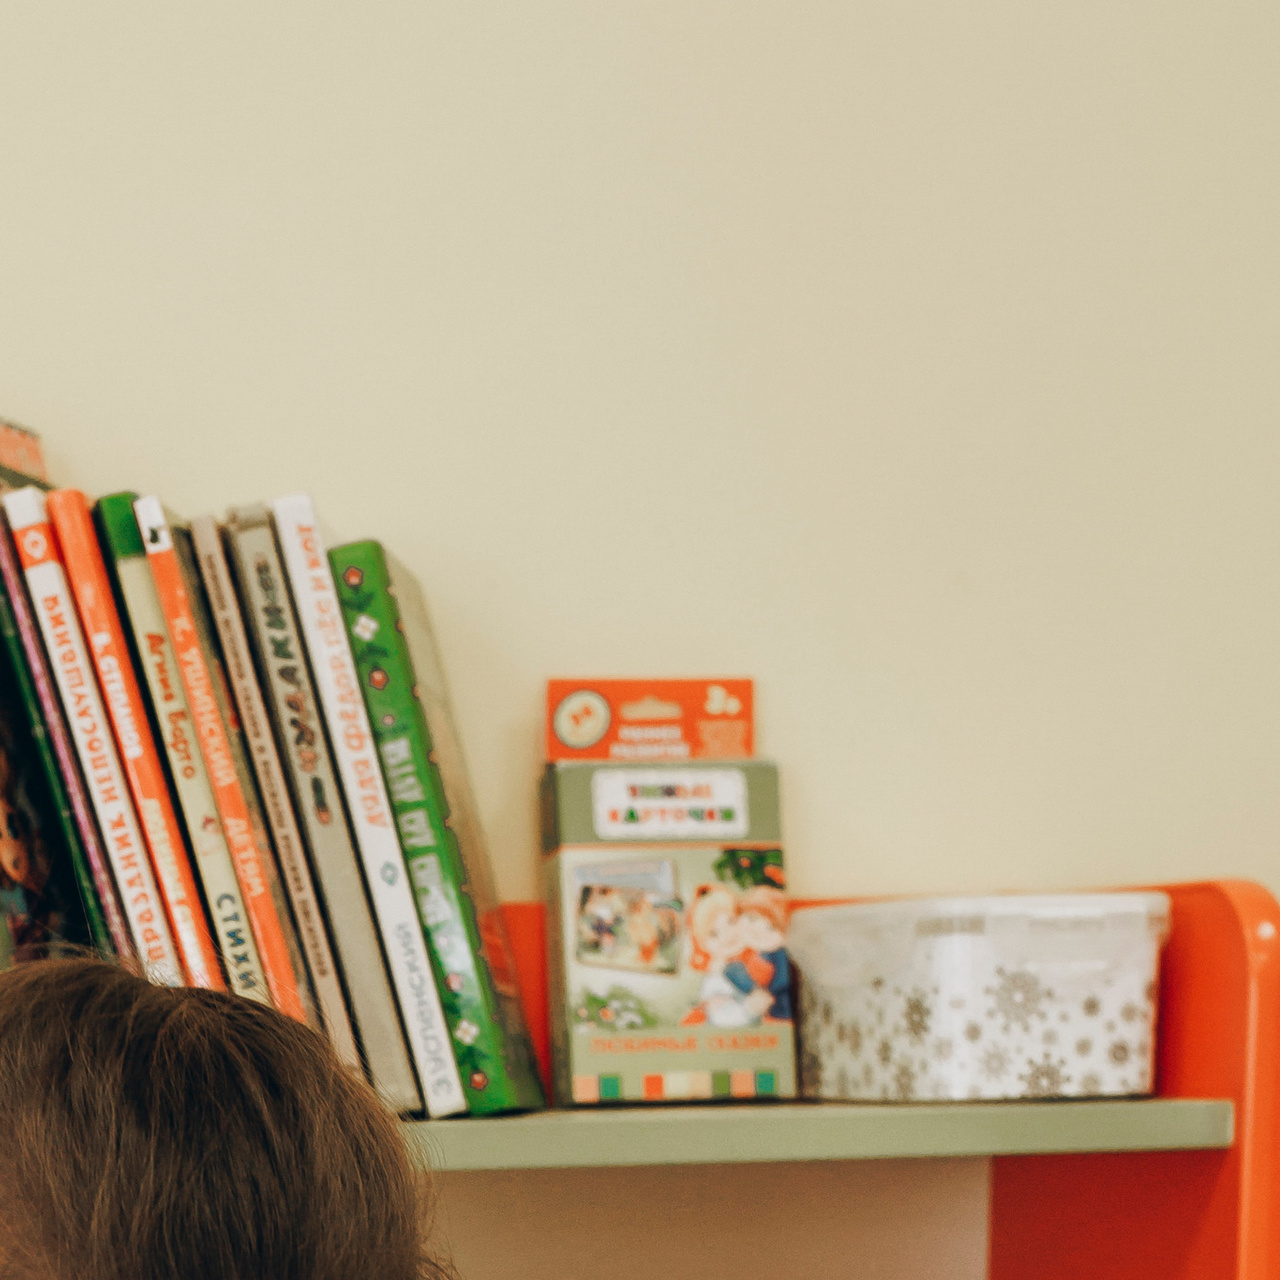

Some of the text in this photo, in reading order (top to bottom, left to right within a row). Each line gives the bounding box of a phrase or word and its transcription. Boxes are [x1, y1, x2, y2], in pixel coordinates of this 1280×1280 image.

[161, 708, 203, 783] Барто
[178, 645, 239, 789] УШИНСКИЙ
[38, 591, 169, 963] ПРАЗДНИК НЕПОСЛУШАНИЯ
[350, 754, 391, 832] ДЯДЯ
[223, 813, 267, 899] ДЕТЯМ
[213, 890, 259, 993] СТИХИ
